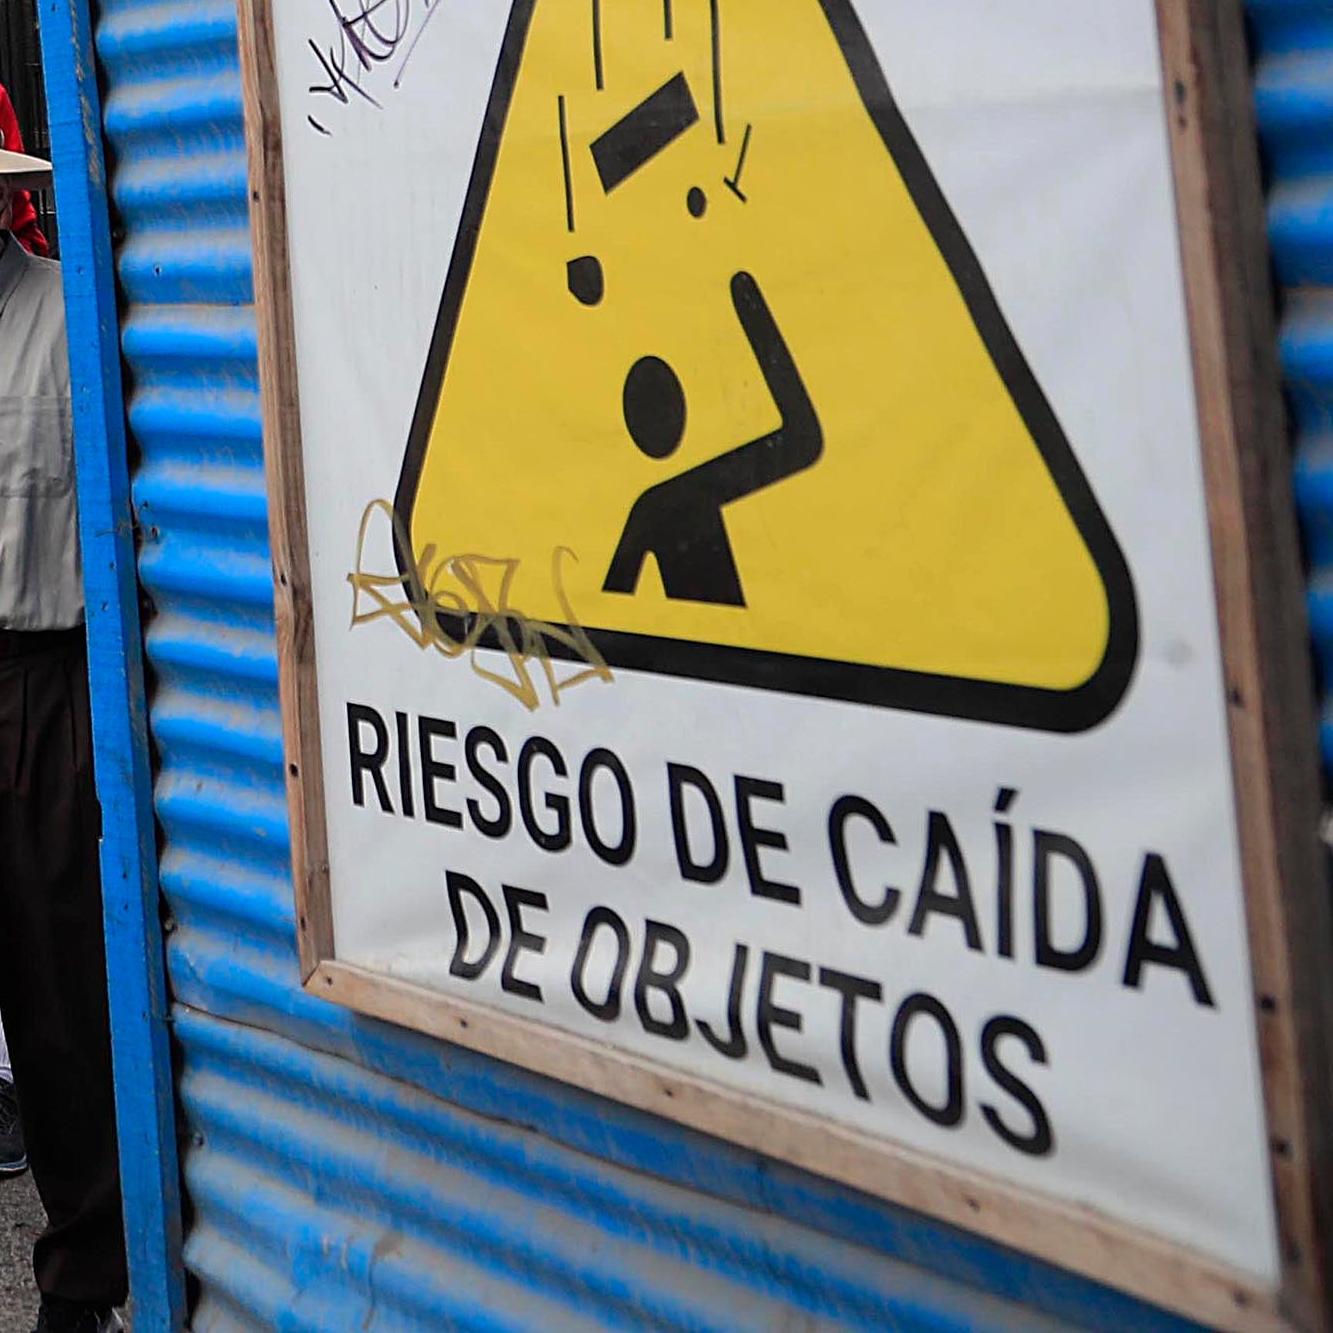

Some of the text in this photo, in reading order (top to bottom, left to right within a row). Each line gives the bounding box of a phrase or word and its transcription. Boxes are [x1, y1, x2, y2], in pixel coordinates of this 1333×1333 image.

[346, 701, 1217, 1011] RIESGO DE CAÍDA
[444, 869, 1056, 1157] DE OBJETOS
